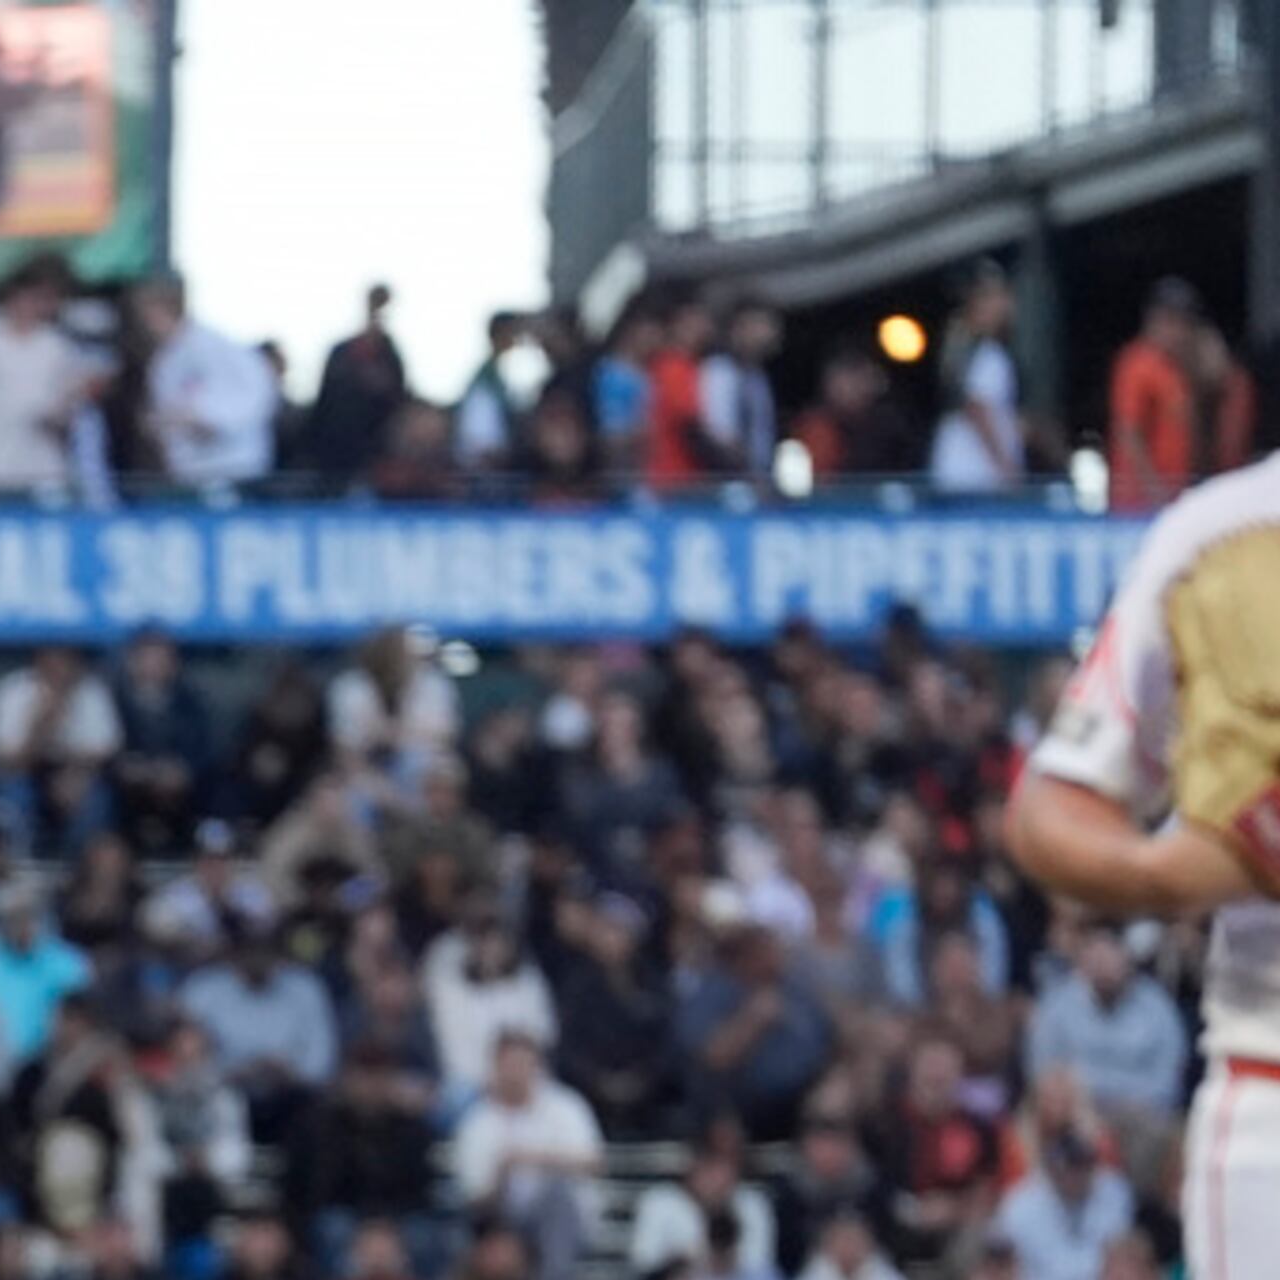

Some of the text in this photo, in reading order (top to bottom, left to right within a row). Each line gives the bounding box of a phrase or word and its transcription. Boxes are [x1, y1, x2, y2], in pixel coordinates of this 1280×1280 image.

[219, 518, 654, 622] PLUMBERS
[672, 520, 734, 626] &
[753, 519, 1140, 626] PIPEFITT
